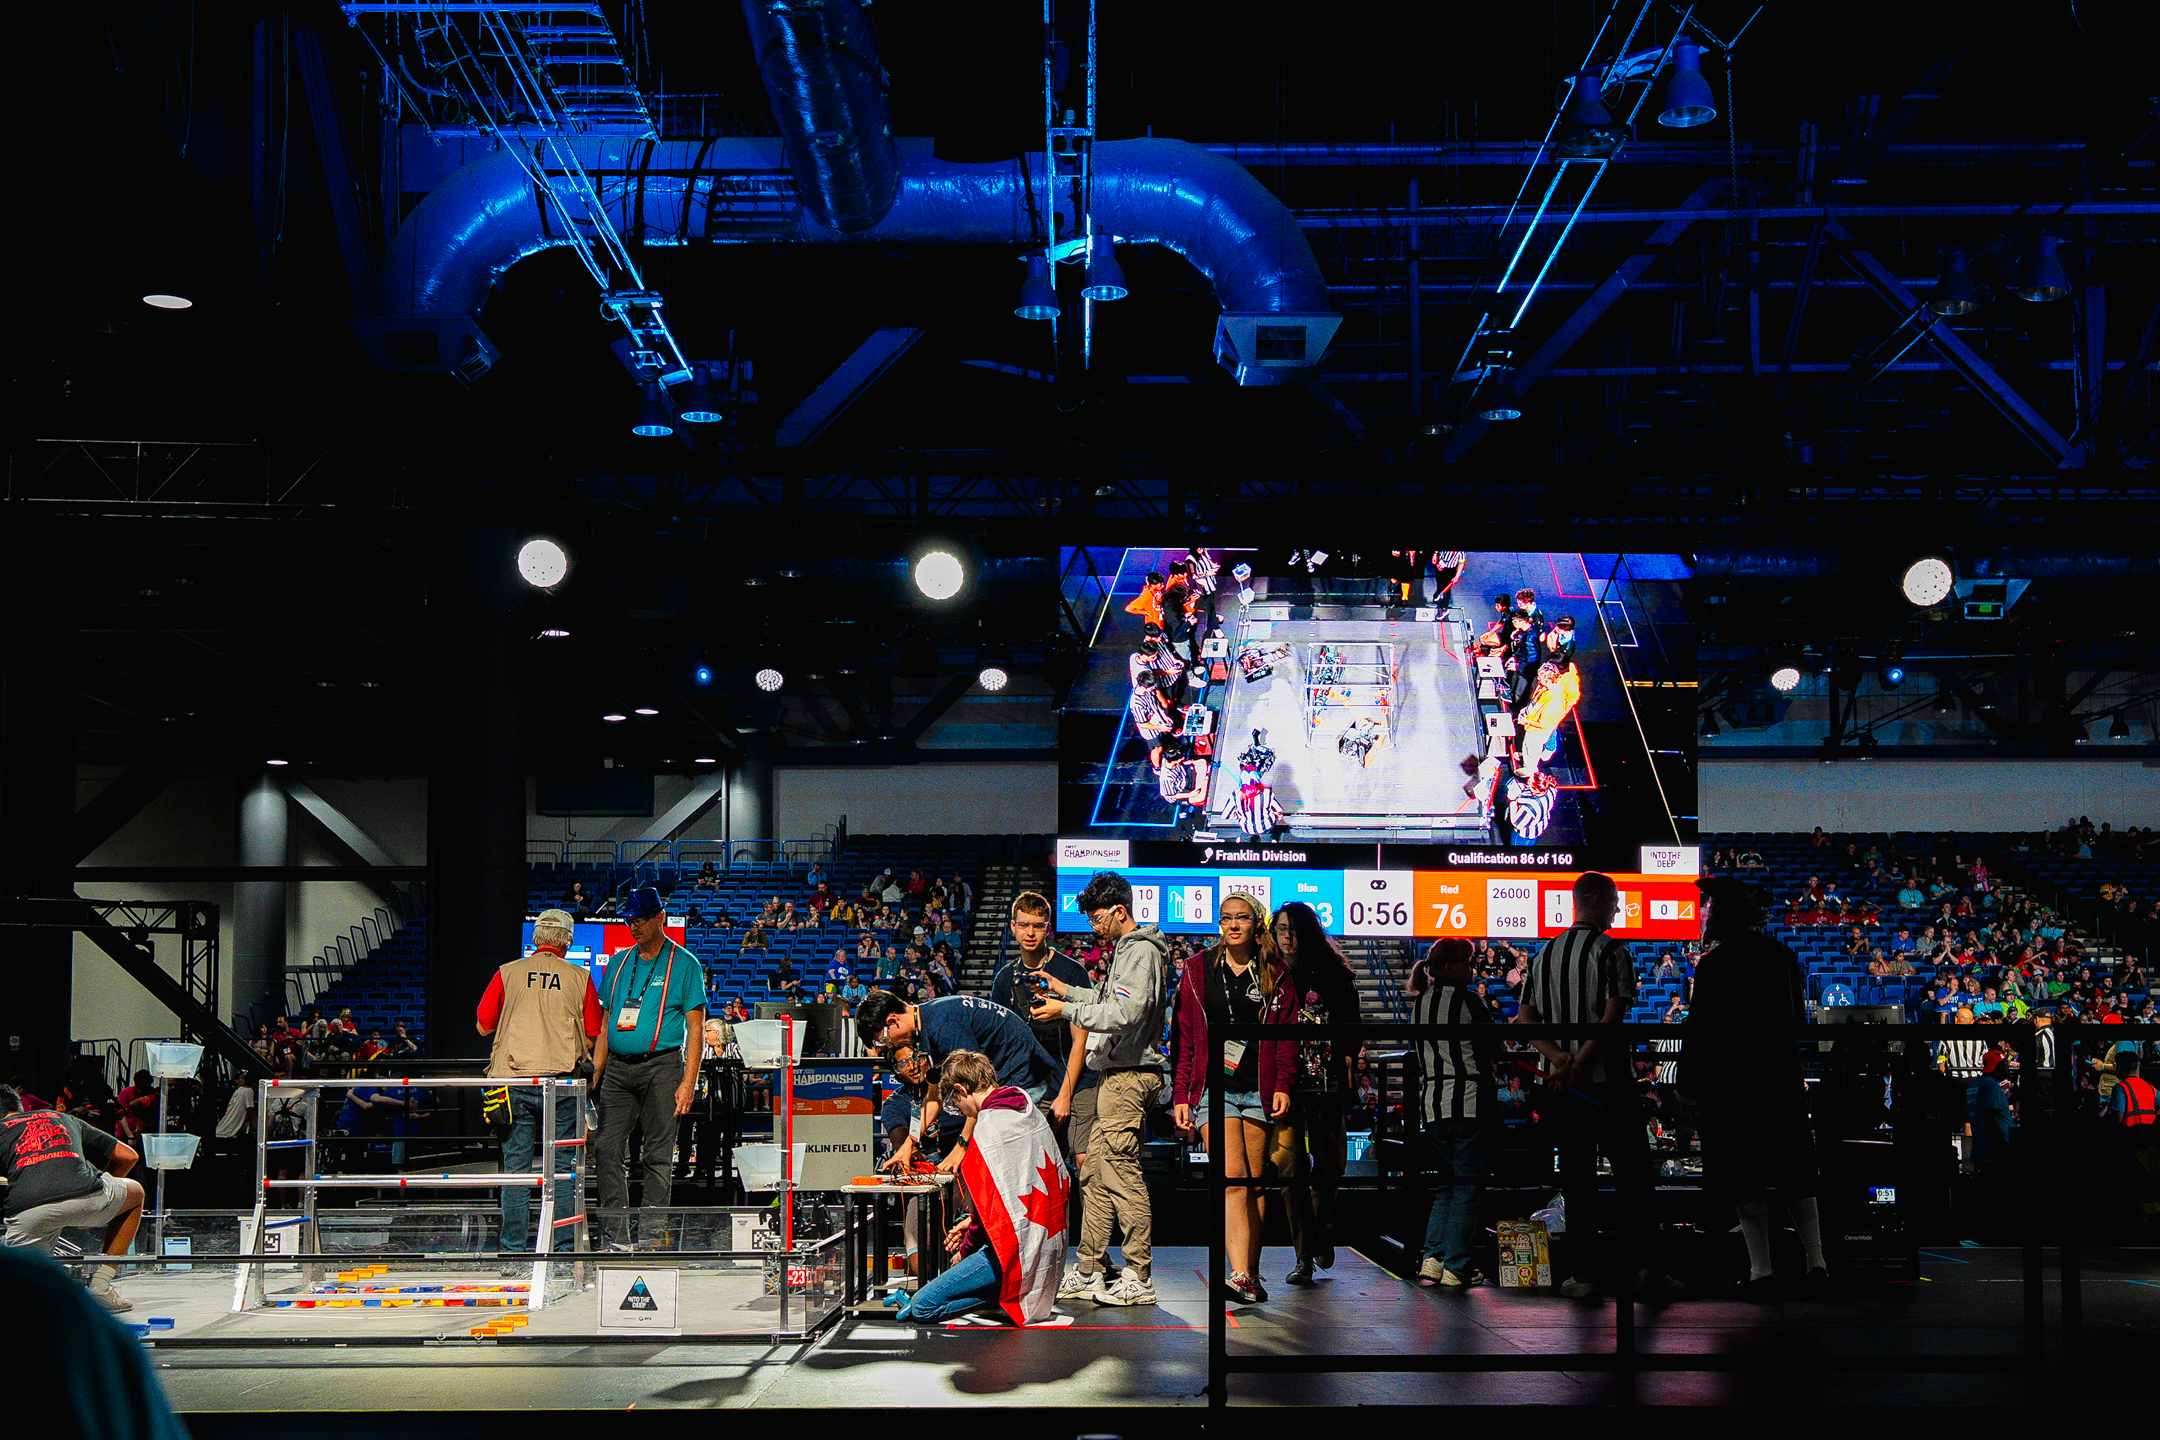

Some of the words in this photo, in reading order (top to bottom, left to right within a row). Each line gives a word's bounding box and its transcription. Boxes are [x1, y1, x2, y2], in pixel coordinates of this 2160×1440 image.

[1064, 849, 1121, 858] CHAMPIONSHIP
[1215, 849, 1261, 862] Franklin
[1262, 850, 1307, 862] Division
[1448, 852, 1518, 866] Qualification
[1520, 853, 1535, 865] 86
[1536, 853, 1549, 865] of
[1550, 853, 1573, 866] 160
[1650, 851, 1667, 860] INTO
[1667, 851, 1682, 861] THE
[1657, 860, 1676, 868] DEEP
[1138, 888, 1154, 900] 10
[1227, 884, 1265, 896] 17315
[1297, 883, 1319, 893] Blue
[1440, 884, 1459, 895] Red
[1492, 888, 1531, 899] 26000
[1194, 889, 1203, 901] 6
[1555, 894, 1561, 905] 1
[1141, 907, 1149, 919] 0
[1194, 908, 1202, 920] 0
[1350, 902, 1408, 926] 0:56
[1432, 903, 1467, 929] 76
[1660, 904, 1668, 916] 0
[1496, 916, 1527, 928] 6988
[1555, 912, 1563, 924] 0
[527, 971, 562, 991] FTA
[793, 1074, 864, 1086] HAMPIONSHIP
[805, 1144, 831, 1153] KLIN
[833, 1144, 860, 1152] FIELD
[862, 1143, 867, 1152] 1
[639, 1296, 651, 1304] THE
